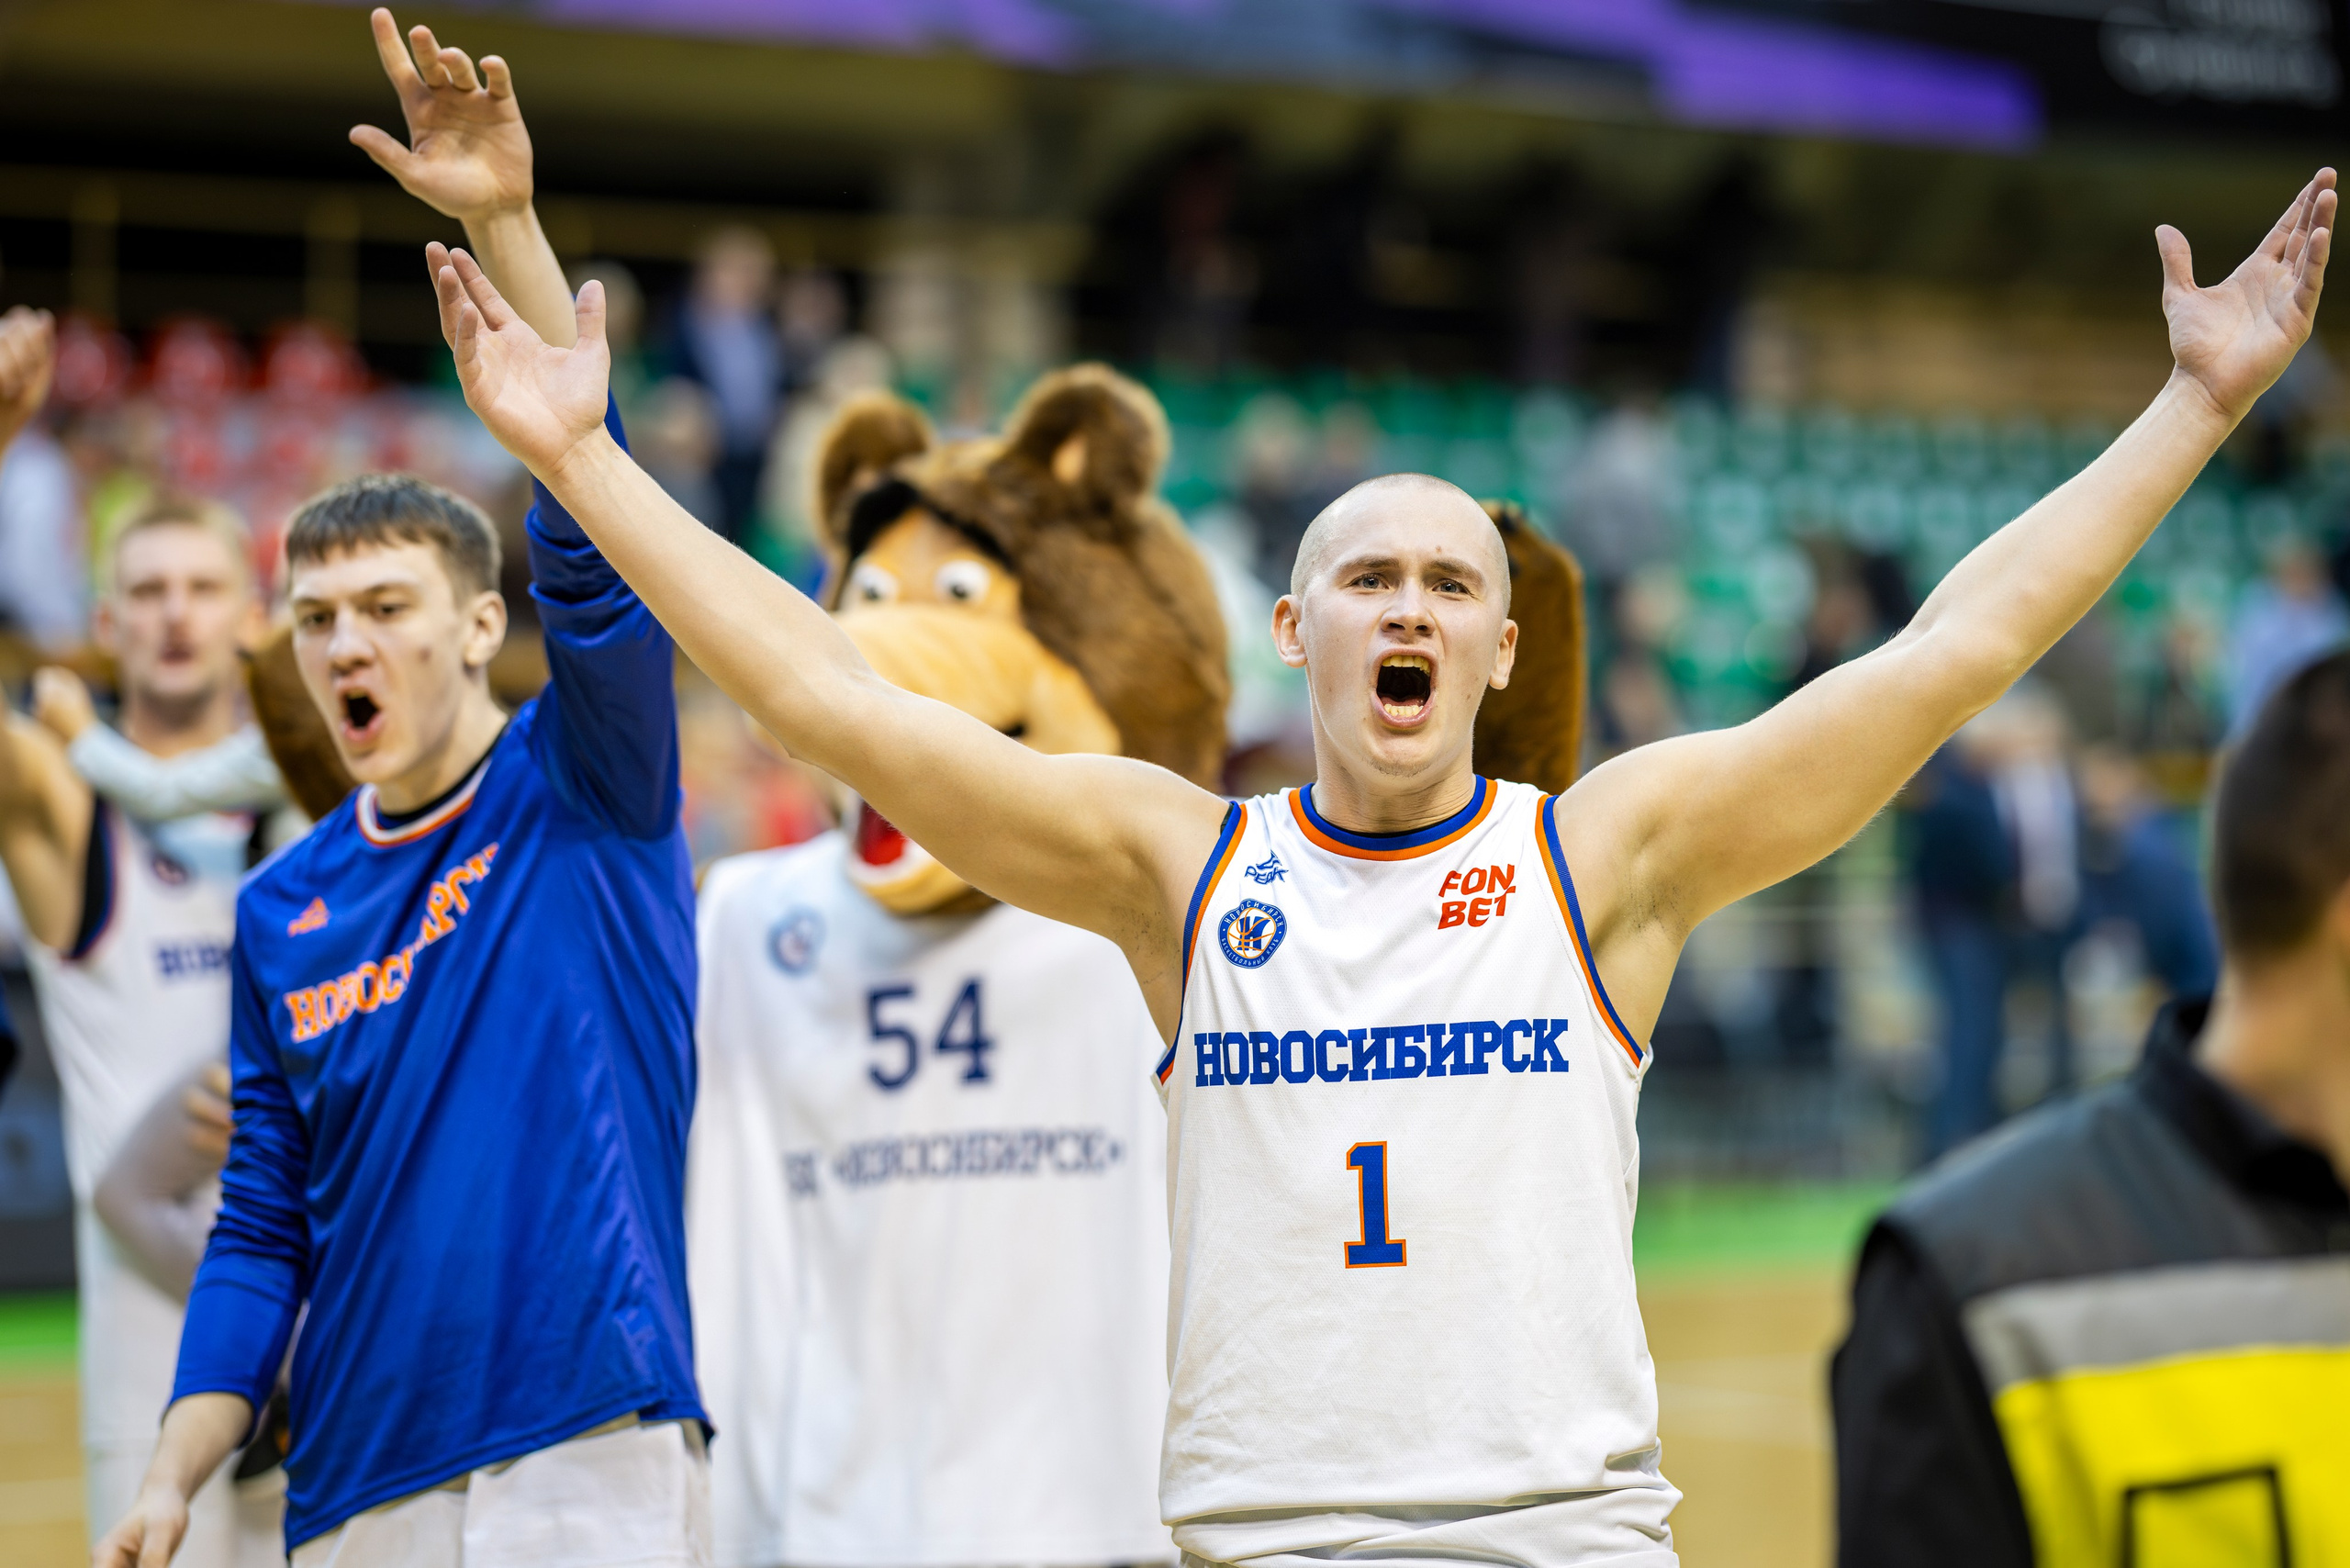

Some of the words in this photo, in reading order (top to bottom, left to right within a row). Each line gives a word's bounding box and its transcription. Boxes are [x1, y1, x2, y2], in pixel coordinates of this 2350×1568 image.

[1244, 865, 1289, 885] PEAK
[1438, 863, 1516, 898] FON
[1437, 885, 1516, 930] BET
[867, 977, 997, 1092] 54
[1194, 1018, 1570, 1088] НОВОСИБИРСК
[1344, 1141, 1407, 1269] 1
